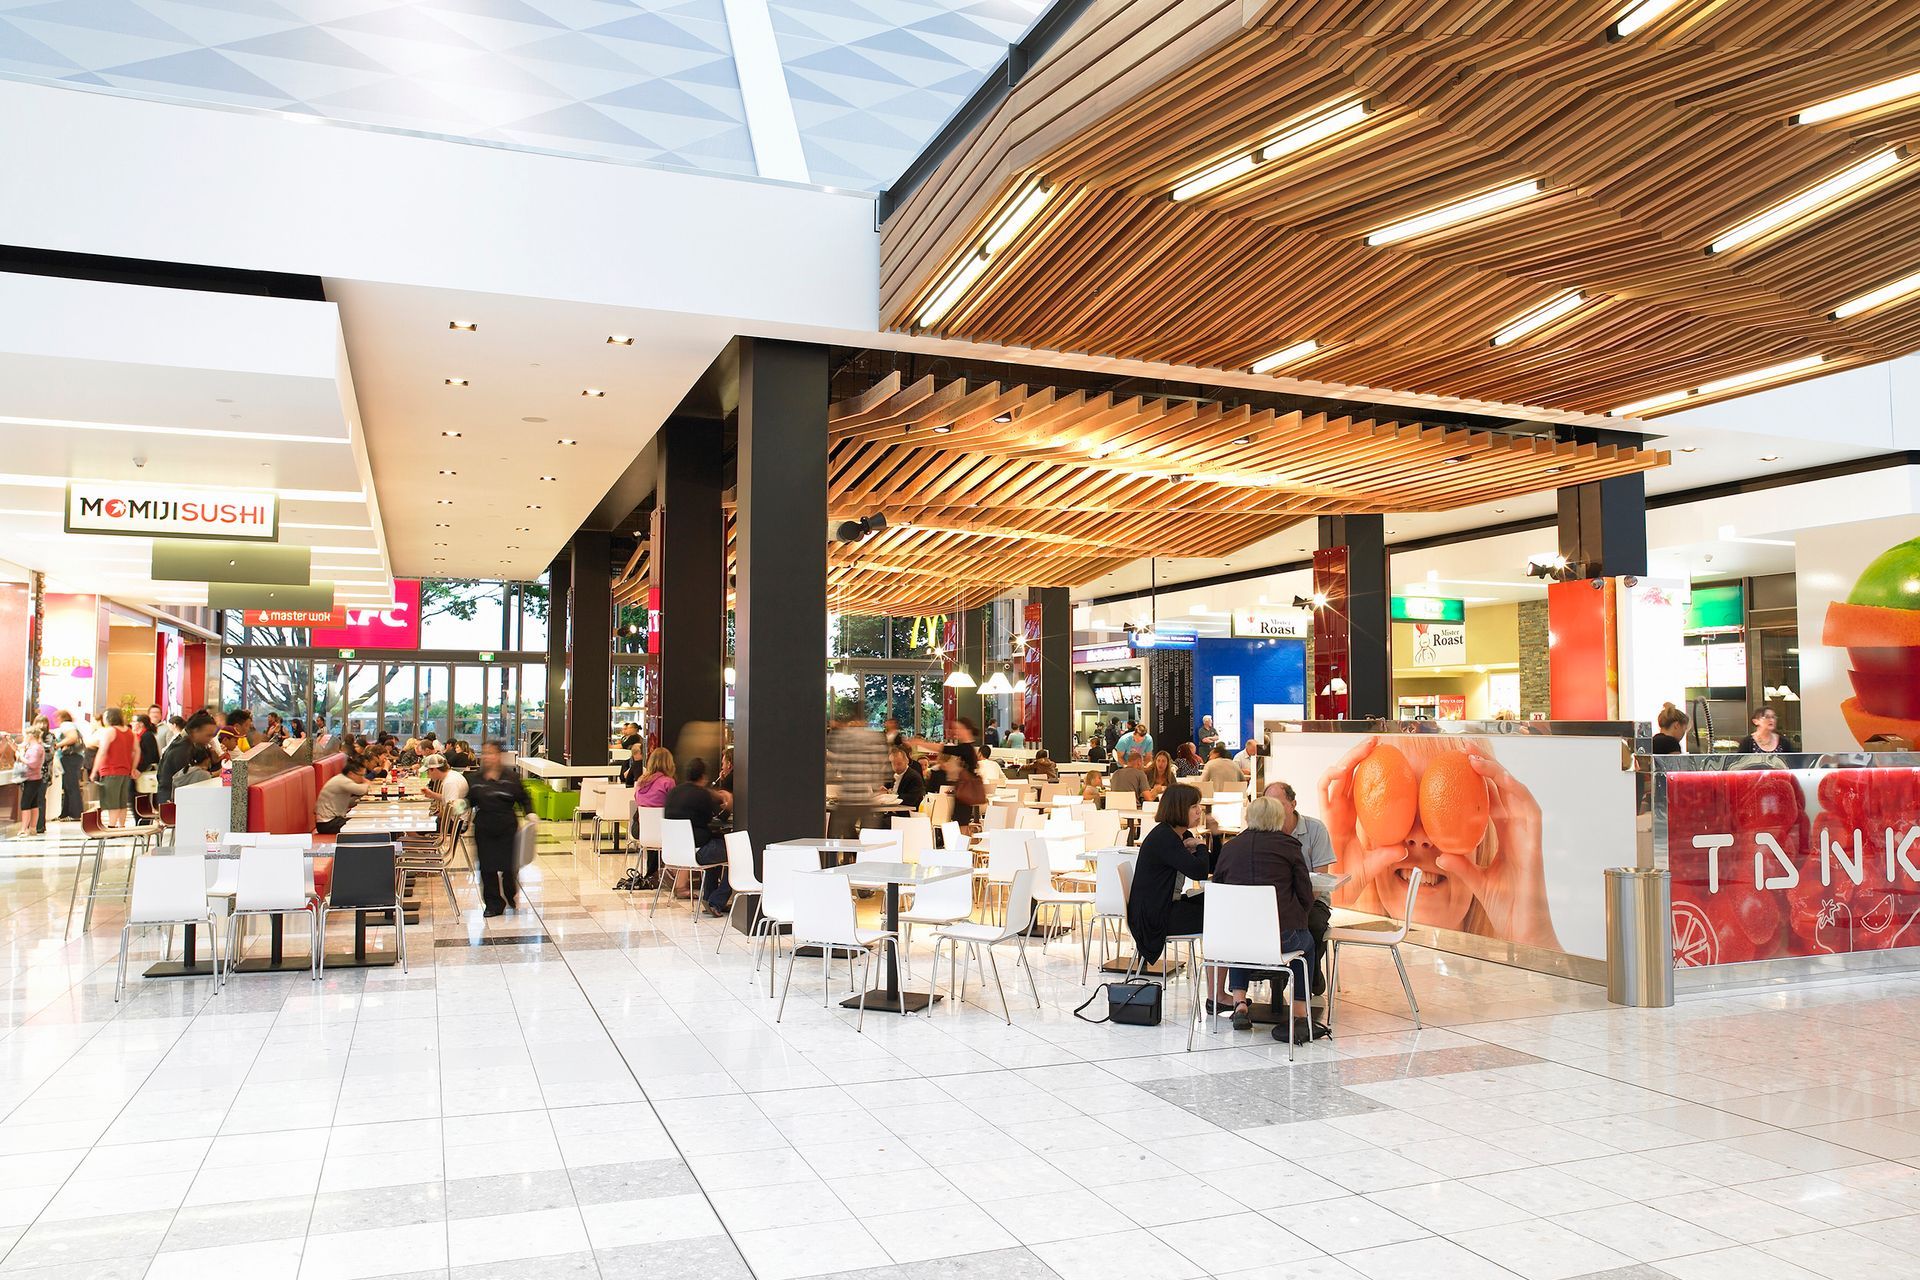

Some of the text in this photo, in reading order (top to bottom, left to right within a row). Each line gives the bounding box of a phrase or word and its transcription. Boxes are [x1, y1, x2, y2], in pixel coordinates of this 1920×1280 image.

[270, 611, 331, 622] master wok
[1260, 622, 1296, 635] Roast
[1433, 633, 1464, 646] Roast
[1691, 825, 1920, 894] TANK
